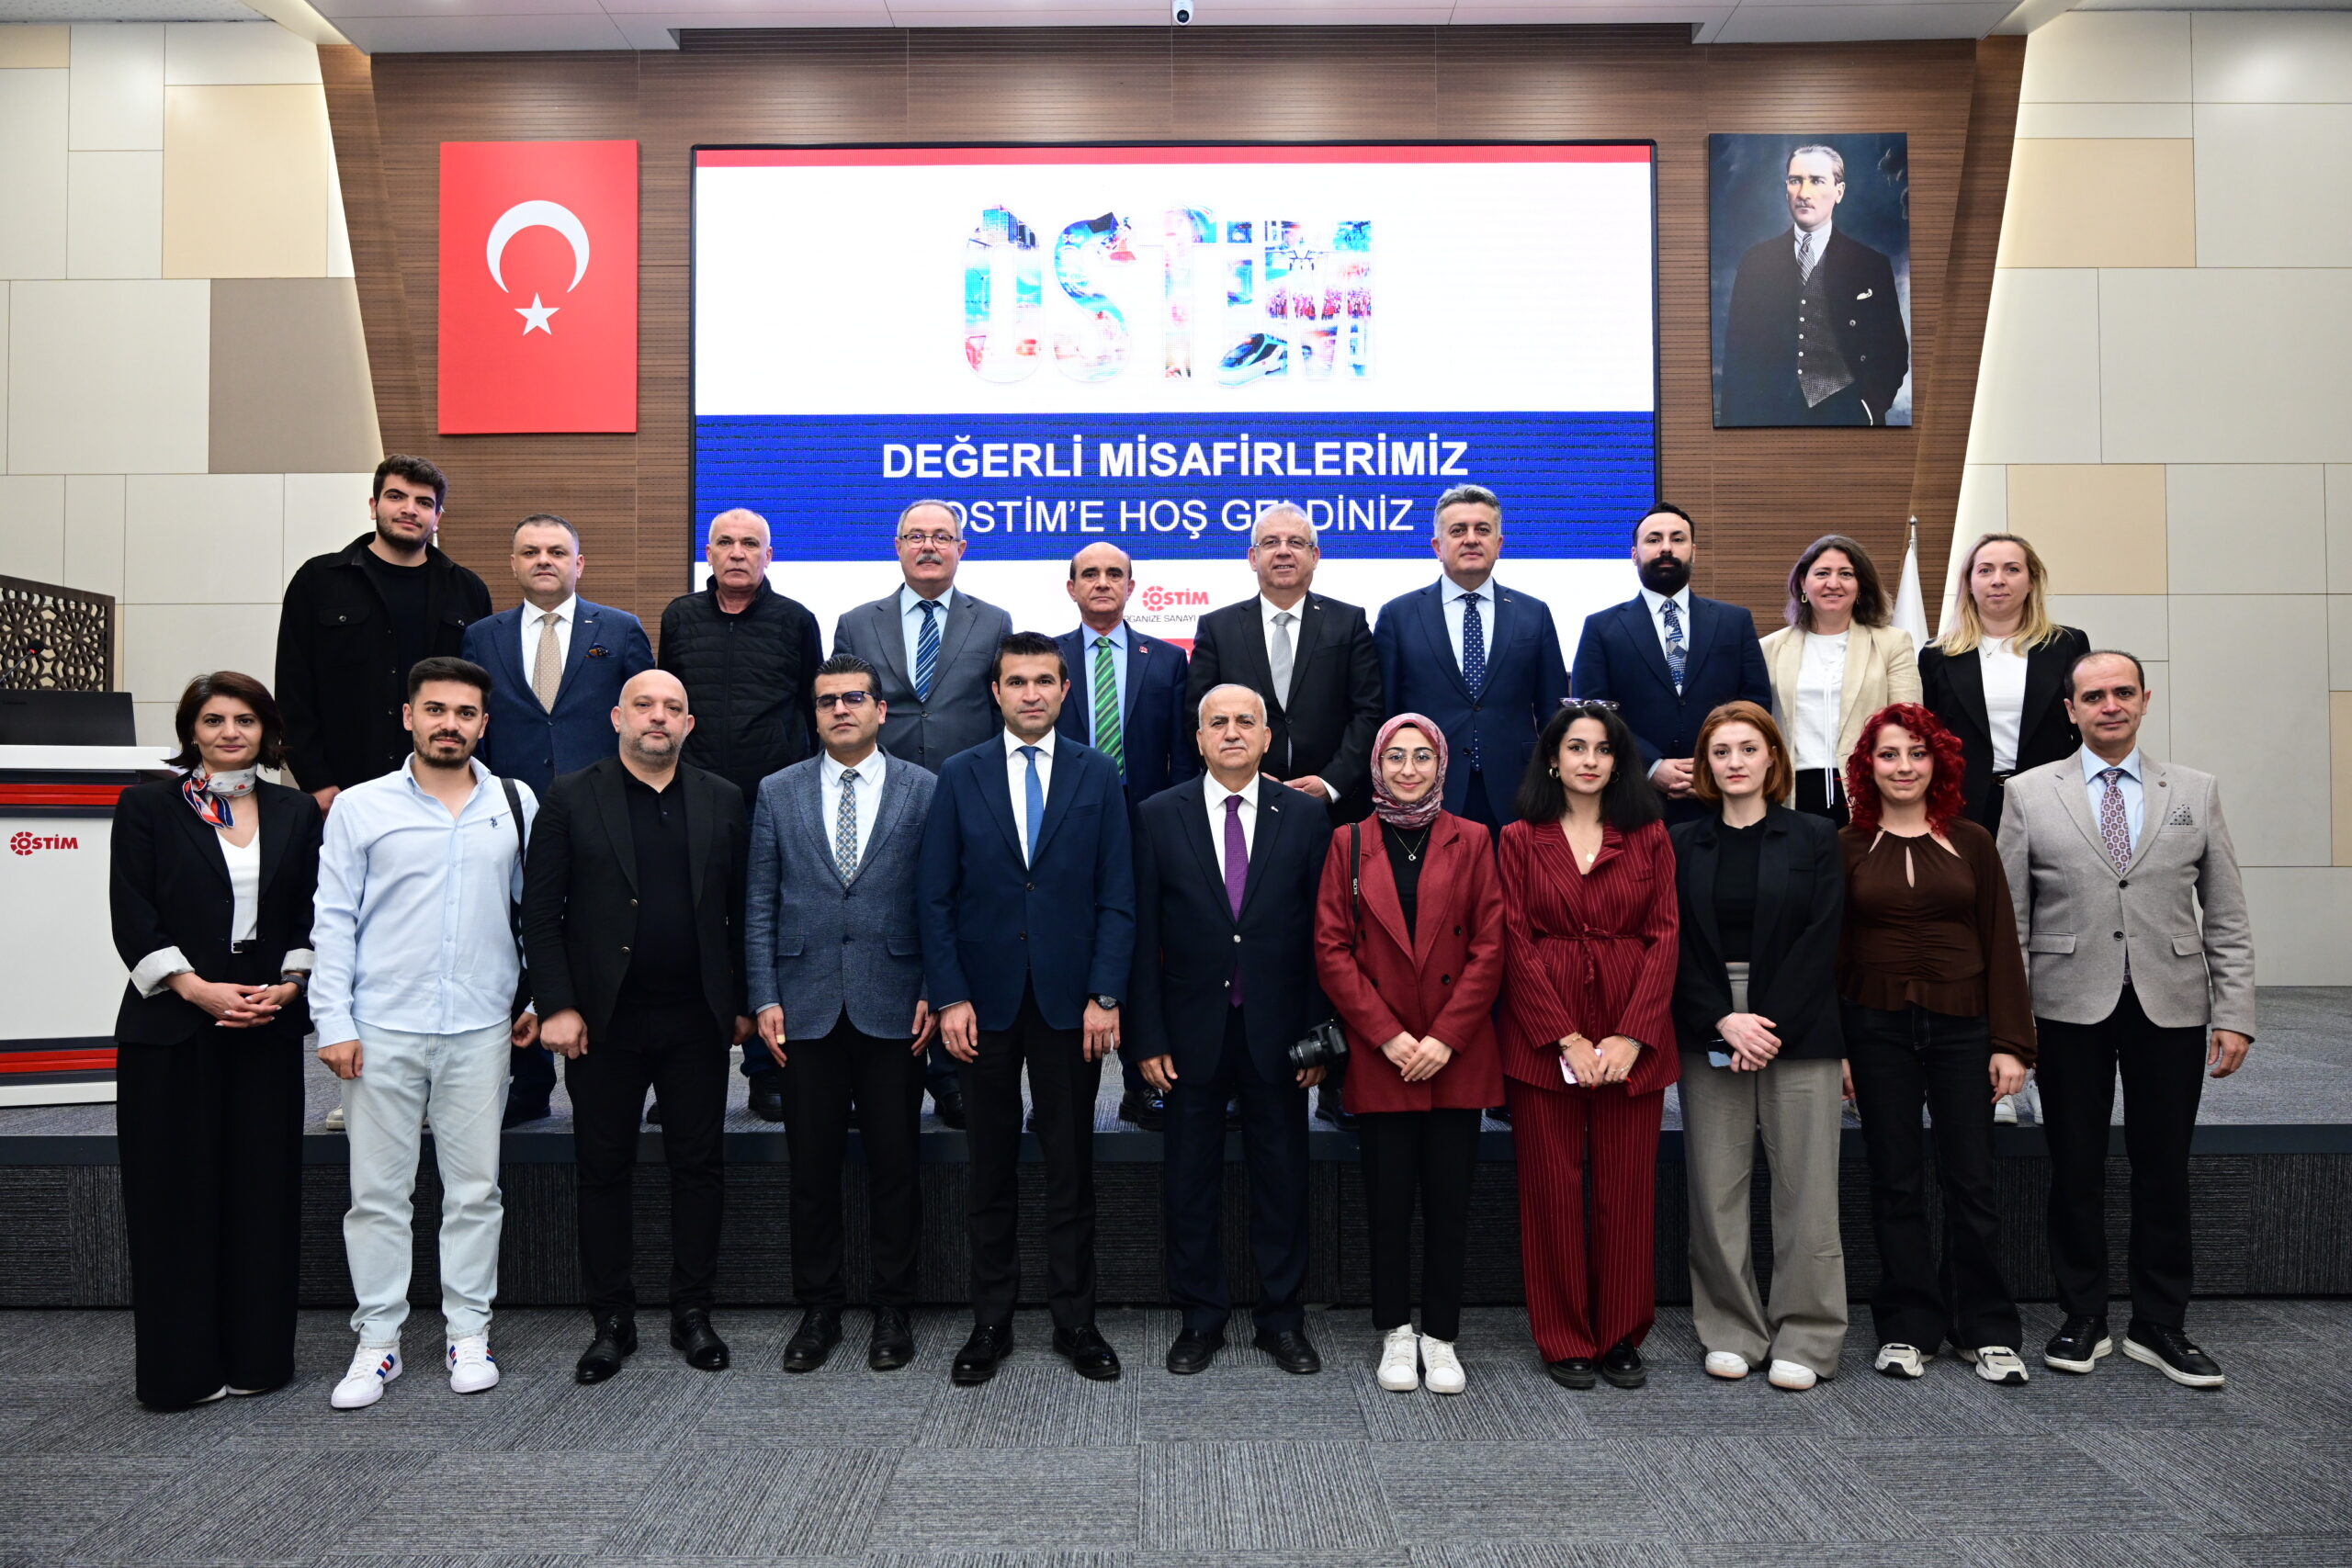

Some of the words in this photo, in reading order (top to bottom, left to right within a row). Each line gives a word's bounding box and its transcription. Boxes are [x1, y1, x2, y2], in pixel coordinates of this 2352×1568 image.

[883, 434, 1082, 478] DEĞERLİ
[1099, 434, 1468, 477] MİSAFİRLERİMİZ
[1120, 500, 1207, 539] HOŞ
[1221, 494, 1414, 531] GDİNİZ
[1148, 588, 1210, 605] OSTİM
[17, 833, 79, 850] OSTİM
